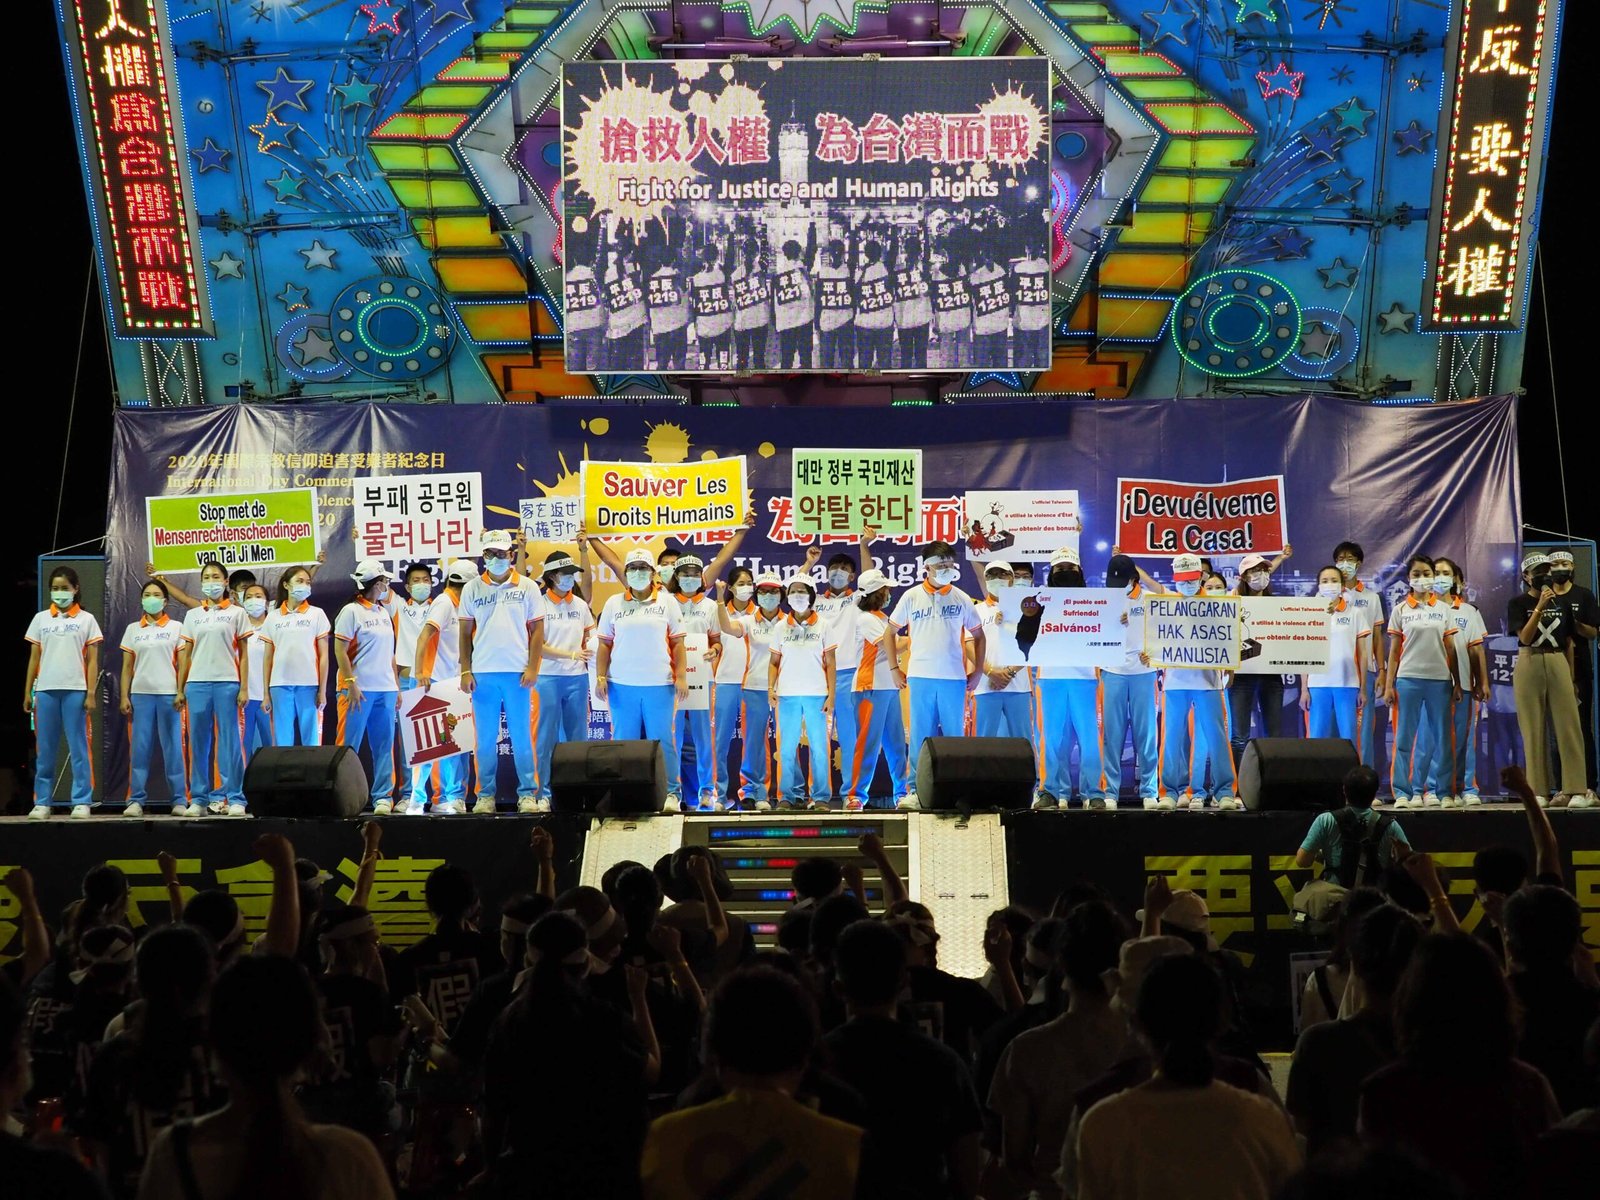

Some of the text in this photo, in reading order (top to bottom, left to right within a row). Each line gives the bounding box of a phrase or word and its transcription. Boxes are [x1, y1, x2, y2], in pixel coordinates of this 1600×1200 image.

[599, 112, 1030, 165] 搶救人權 為台灣而戰
[618, 175, 999, 206] Fight for Justice and Human Rights
[603, 470, 727, 499] Sauver Les
[797, 457, 916, 487] 대만 정부 국민재산
[200, 500, 266, 524] Stop met de
[363, 481, 472, 517] 부패 공무원
[799, 493, 853, 531] 약탈
[858, 493, 913, 530] 한다
[1123, 485, 1277, 523] ¡Devuélveme
[597, 500, 735, 528] Droits Humains
[154, 521, 311, 546] Mensenrechtenschendingen
[362, 518, 473, 556] 물러나라
[1147, 521, 1253, 552] La Casa!
[219, 546, 236, 564] Tai
[239, 545, 250, 563] Ji
[251, 544, 274, 562] Men
[504, 590, 526, 601] MEN
[941, 604, 963, 616] MEN
[1063, 609, 1099, 617] Sufriendo!
[1150, 600, 1237, 619] PELANGGARAN
[1041, 622, 1101, 635] ¡Salvános!
[1158, 624, 1233, 641] HAK ASASI
[1162, 646, 1231, 664] MANUSIA
